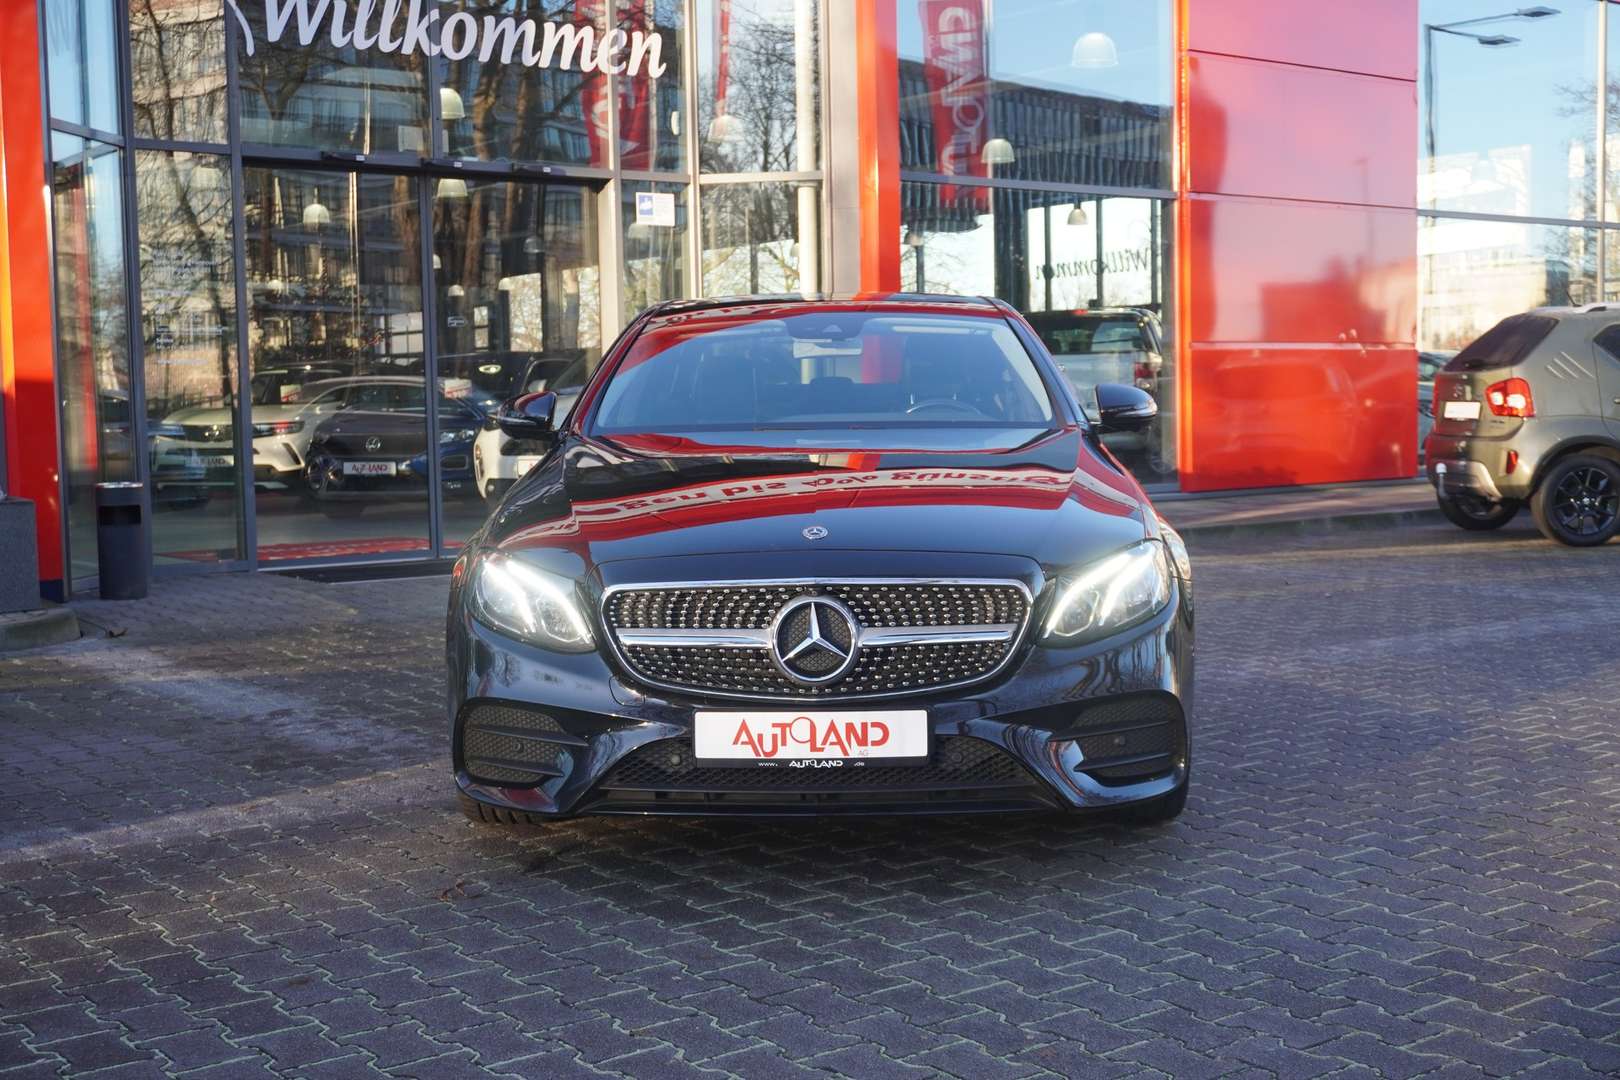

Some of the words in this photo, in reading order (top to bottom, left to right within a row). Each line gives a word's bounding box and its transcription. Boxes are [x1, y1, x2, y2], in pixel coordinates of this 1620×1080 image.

[226, 0, 667, 79] Willkommen
[732, 716, 890, 757] AUTOLAND
[789, 759, 844, 769] AUTOLAND
